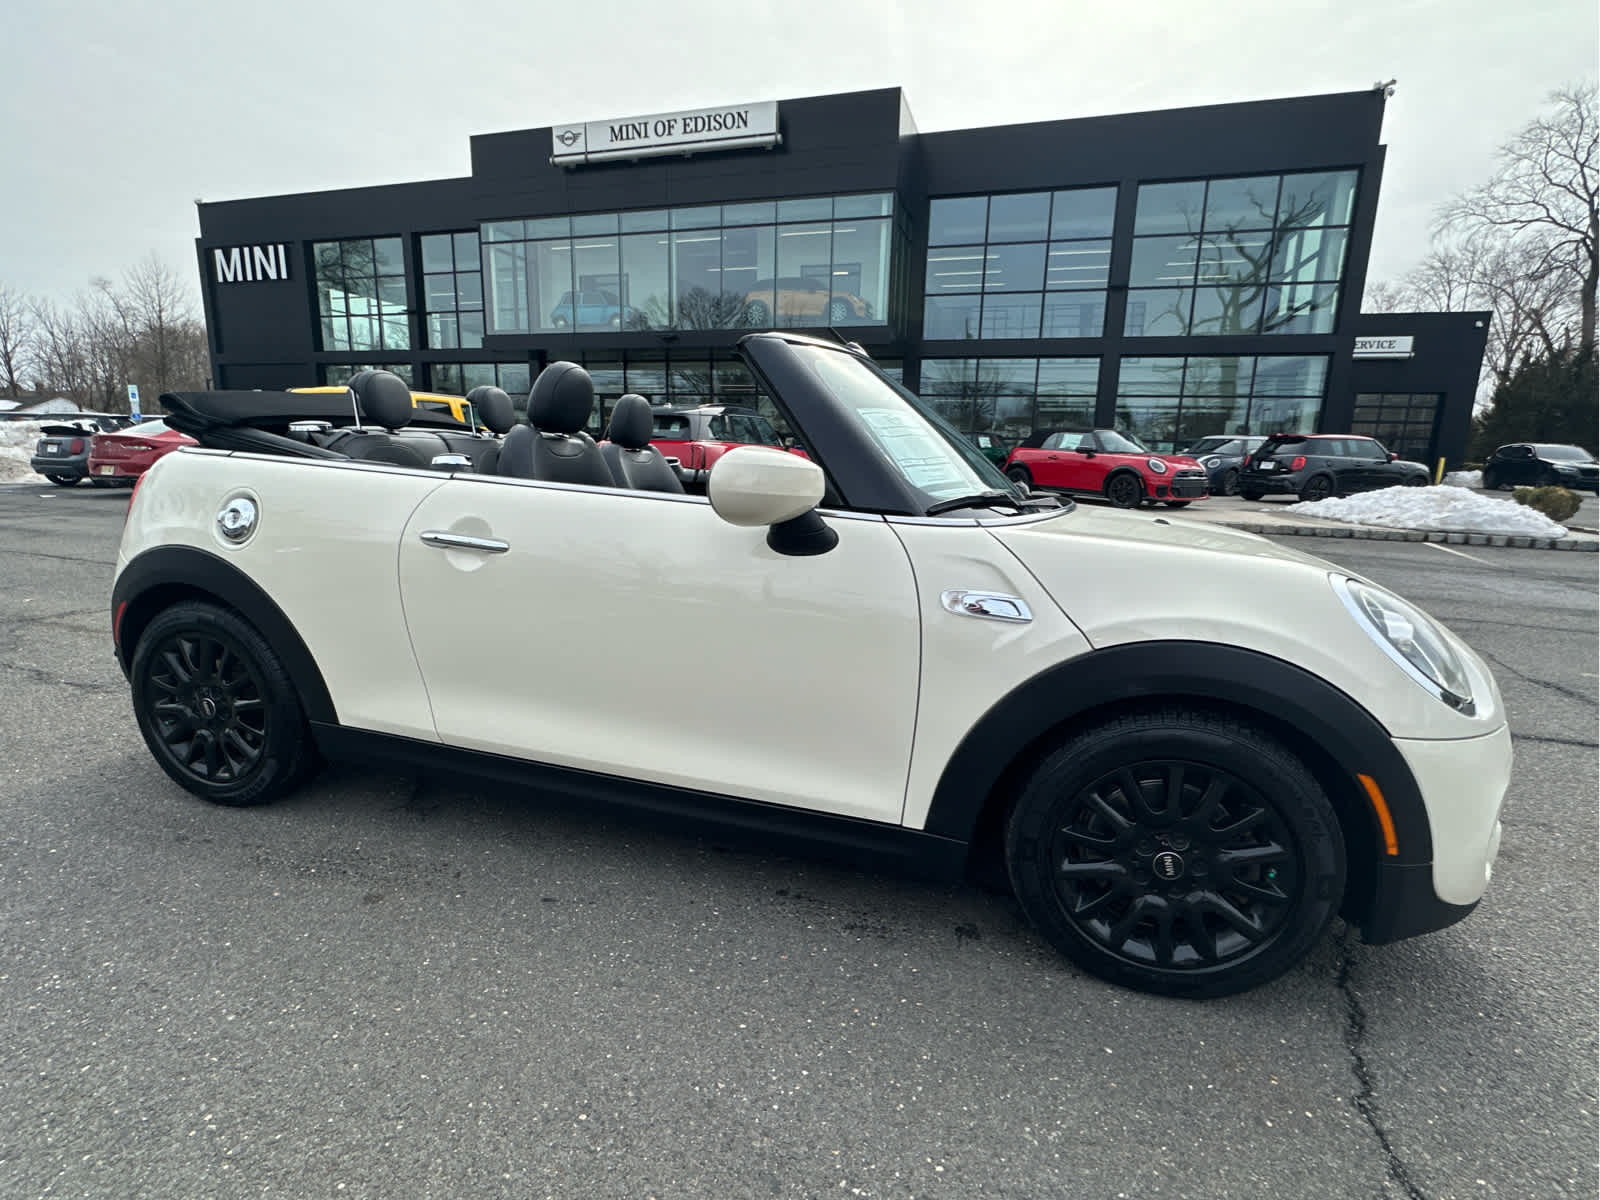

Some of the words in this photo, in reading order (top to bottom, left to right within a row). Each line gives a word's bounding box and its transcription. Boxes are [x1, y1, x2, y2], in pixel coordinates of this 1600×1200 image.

[609, 122, 649, 142] MINI
[654, 119, 678, 137] OF
[682, 110, 749, 134] EDISON
[214, 244, 288, 283] MINI
[1355, 340, 1397, 350] ERVICE
